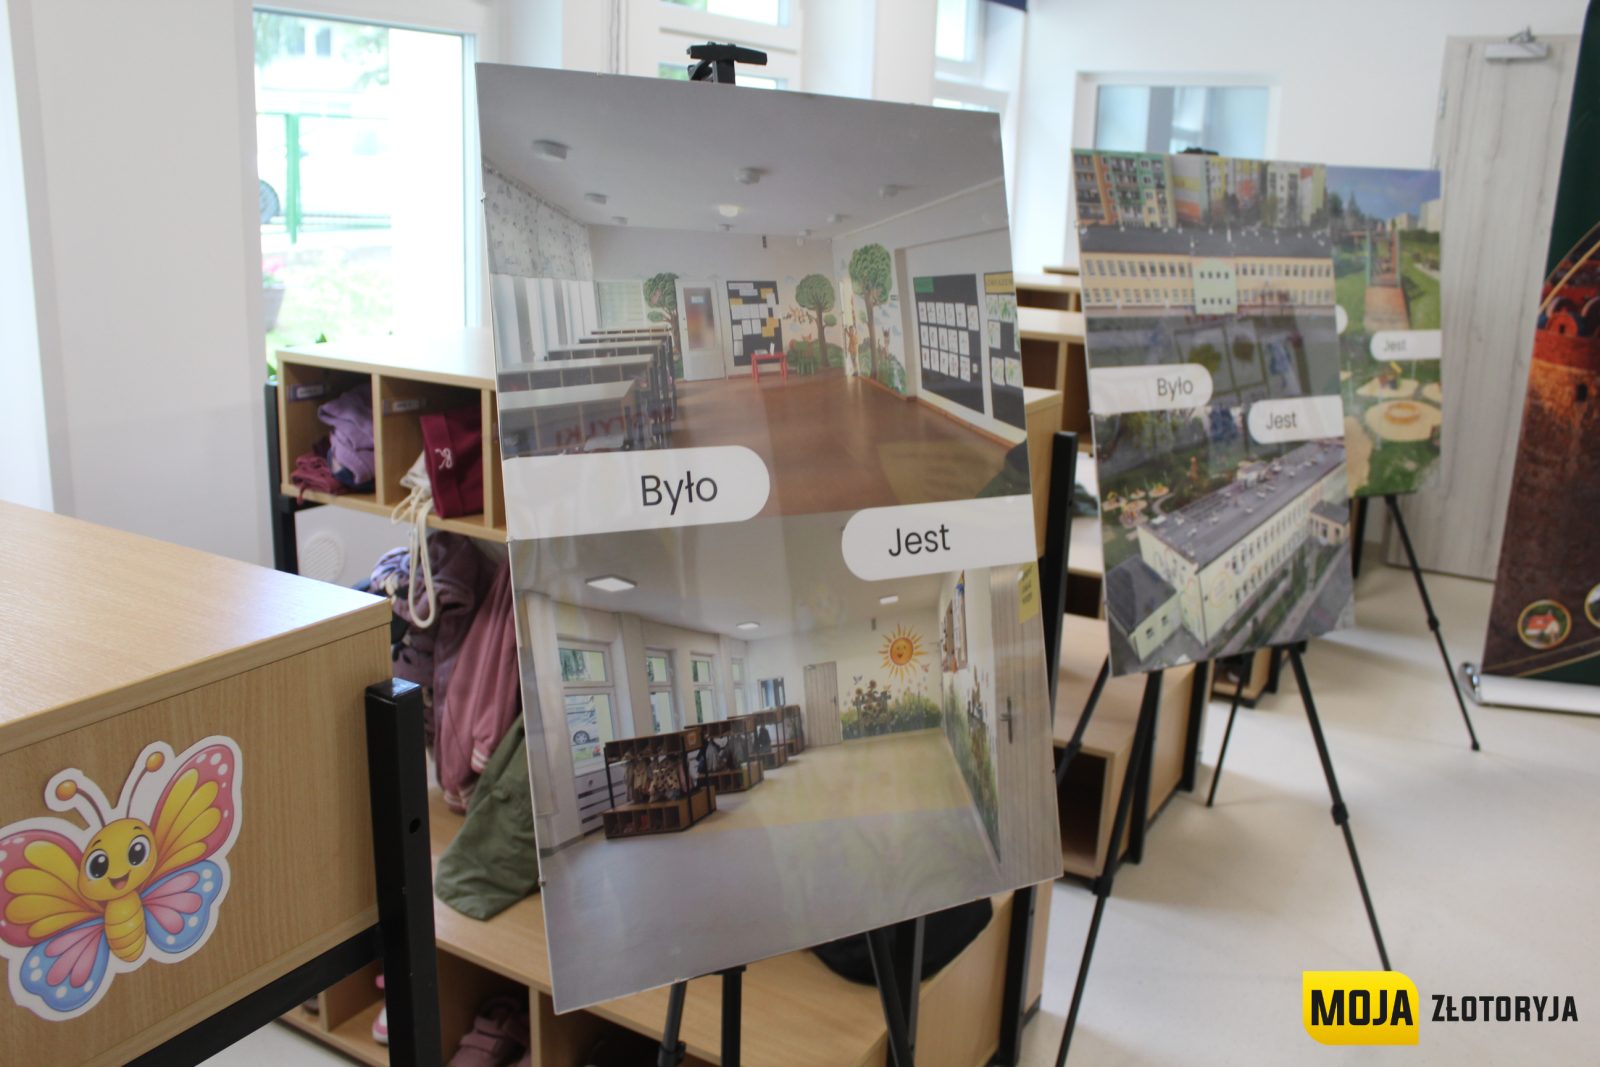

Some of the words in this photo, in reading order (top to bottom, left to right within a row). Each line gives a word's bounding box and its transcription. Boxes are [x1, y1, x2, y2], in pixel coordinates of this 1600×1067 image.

[1156, 376, 1194, 402] Było
[1265, 411, 1297, 430] Jest
[641, 470, 718, 516] Było
[888, 524, 951, 557] Jest
